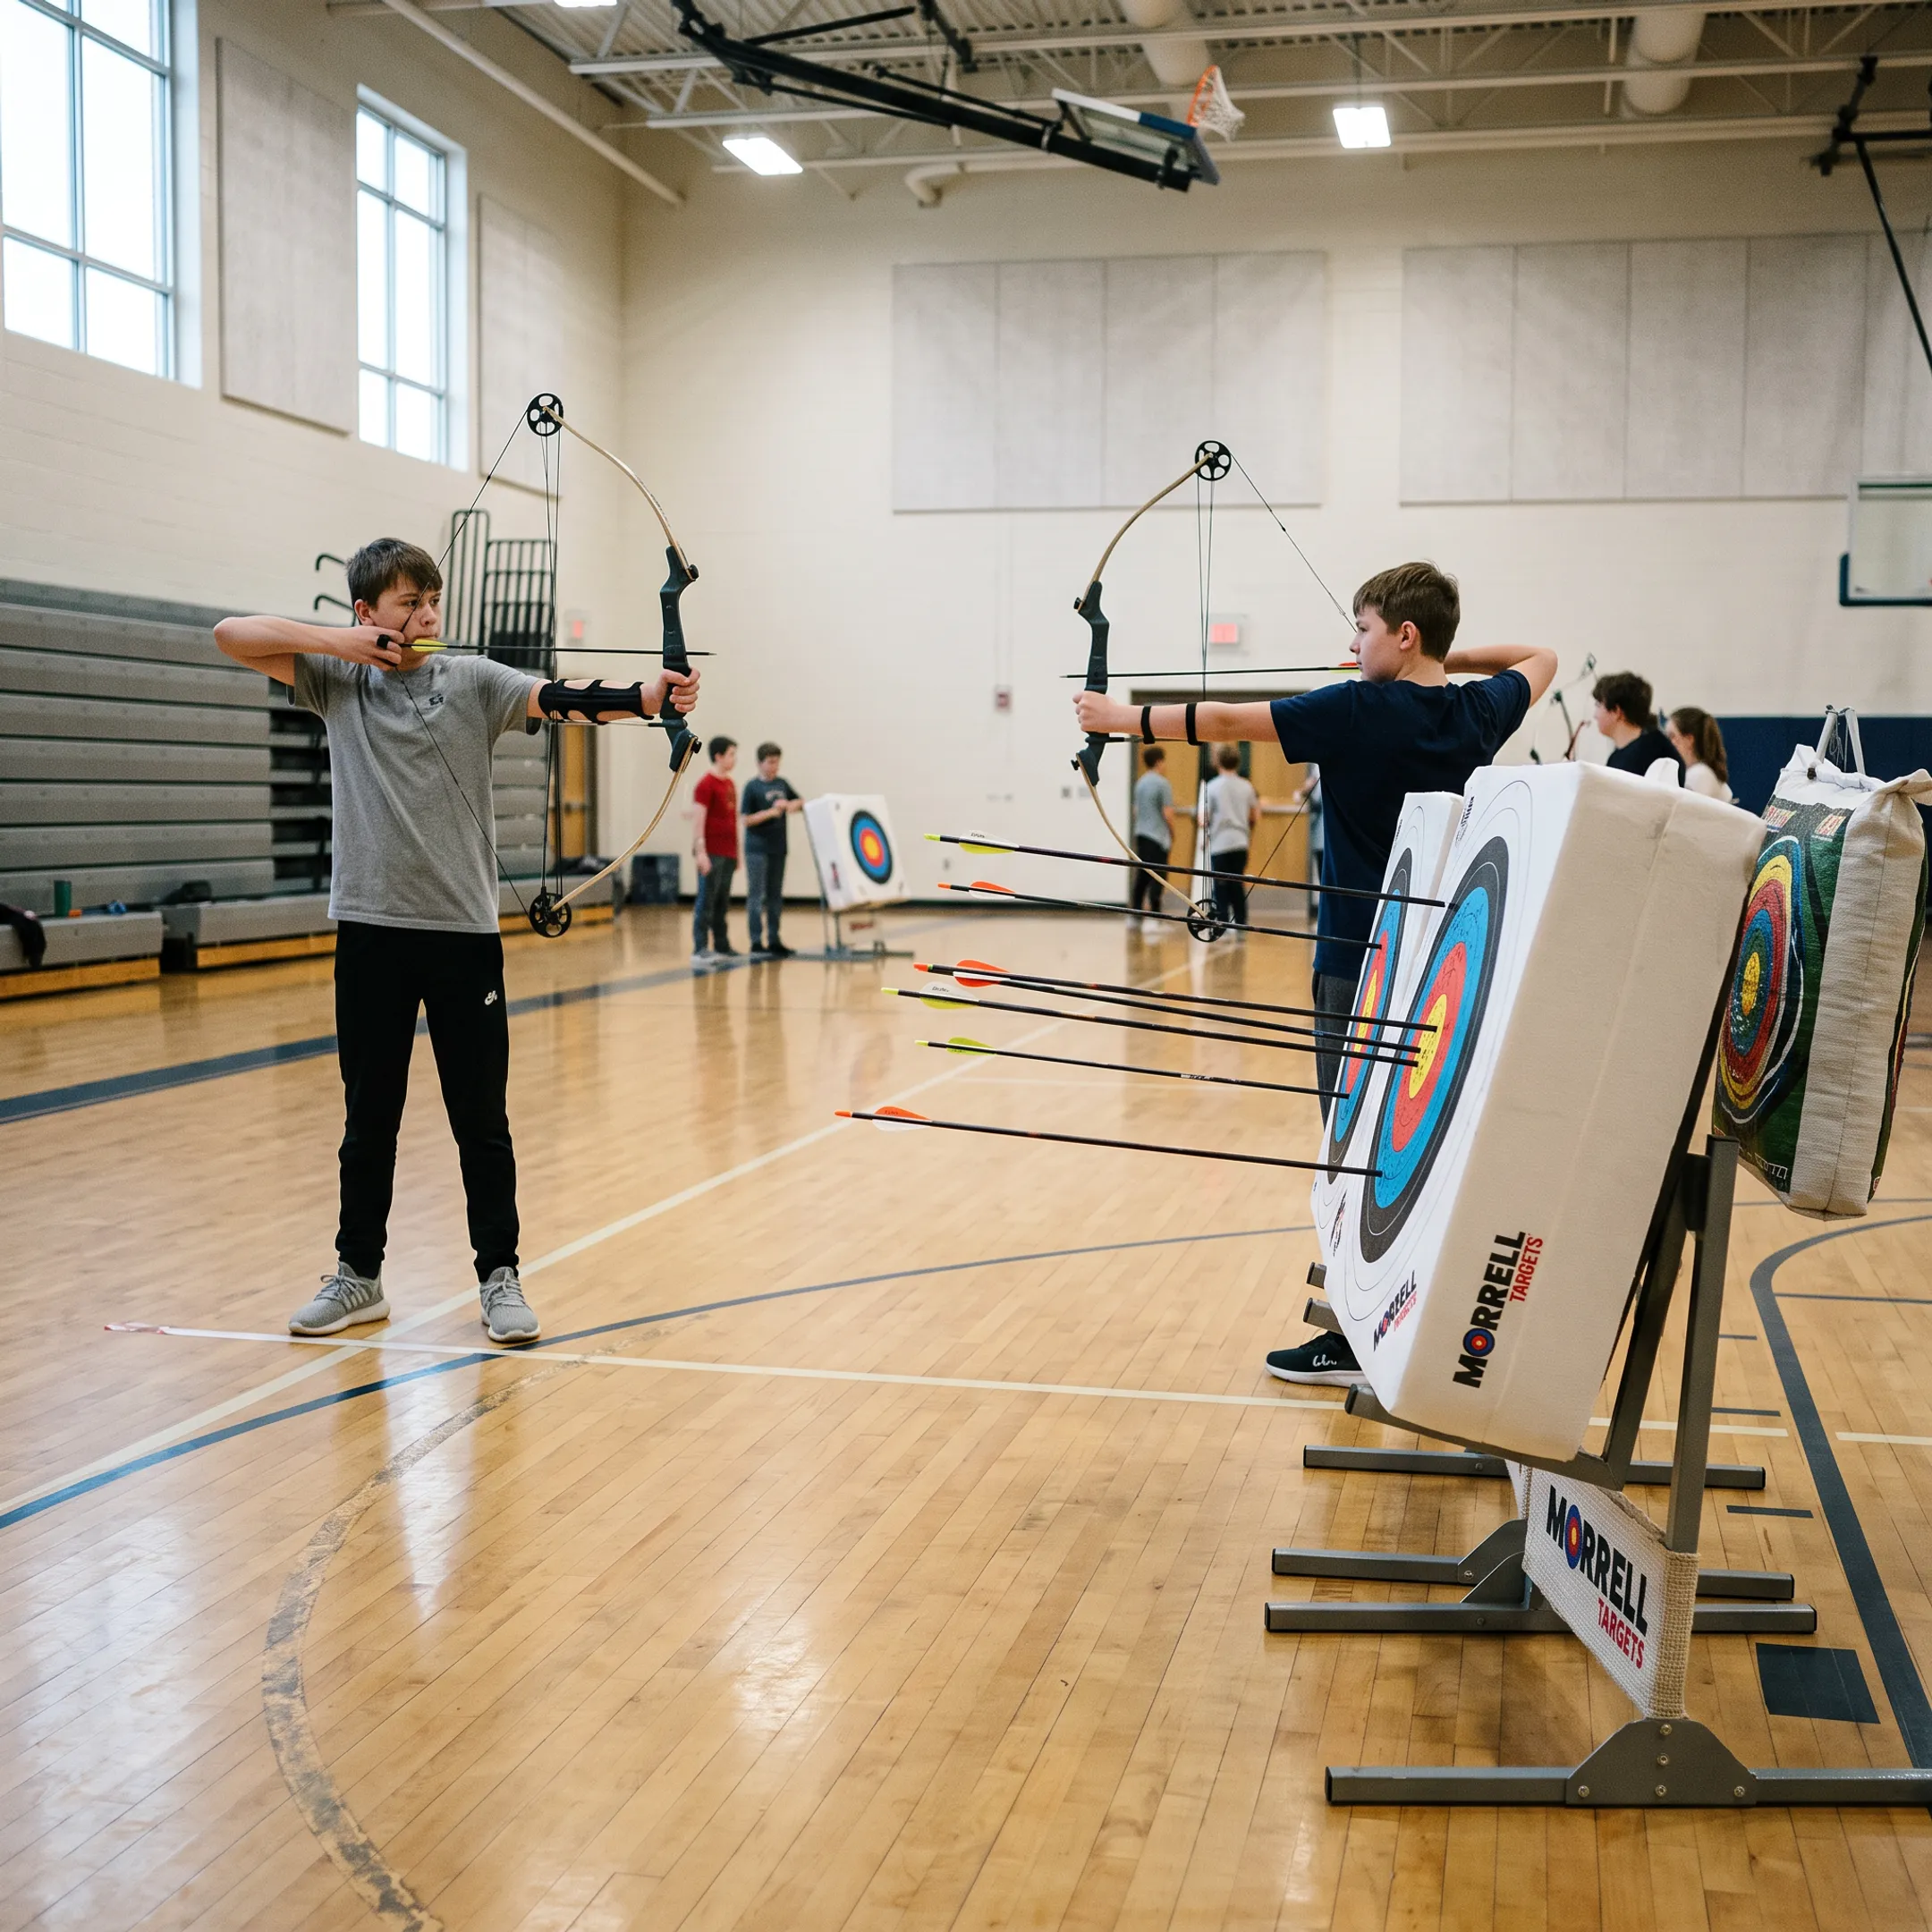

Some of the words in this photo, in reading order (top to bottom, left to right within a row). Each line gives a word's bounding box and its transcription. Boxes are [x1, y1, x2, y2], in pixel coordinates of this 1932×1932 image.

[1453, 1232, 1526, 1388] MORRELL
[1509, 1234, 1544, 1301] TARGETS
[1546, 1485, 1648, 1637] MORRELL
[1597, 1597, 1645, 1669] TARGETS
